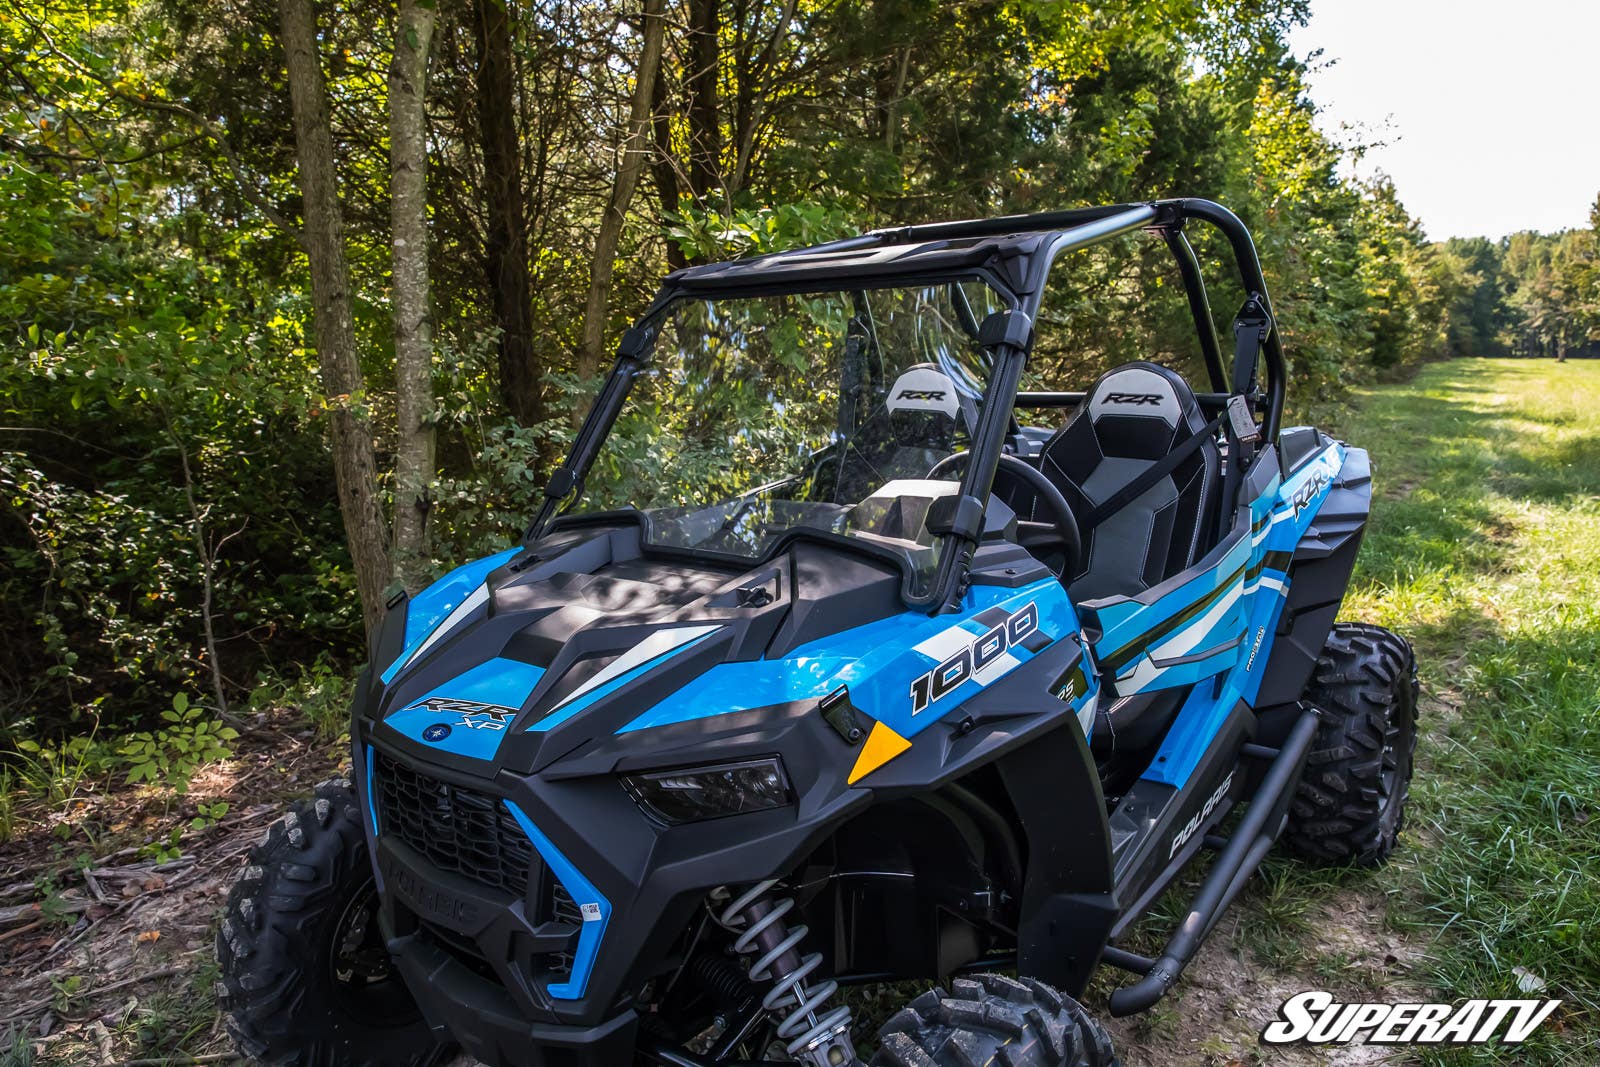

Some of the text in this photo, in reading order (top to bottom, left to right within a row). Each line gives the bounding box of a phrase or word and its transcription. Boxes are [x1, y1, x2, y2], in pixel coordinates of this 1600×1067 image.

[896, 389, 947, 402] RZR
[1100, 392, 1165, 406] RZR
[1290, 466, 1331, 523] RZR
[911, 601, 1039, 716] 1000
[402, 696, 520, 723] RZR
[454, 716, 505, 730] XP
[1168, 770, 1235, 860] POLARIS
